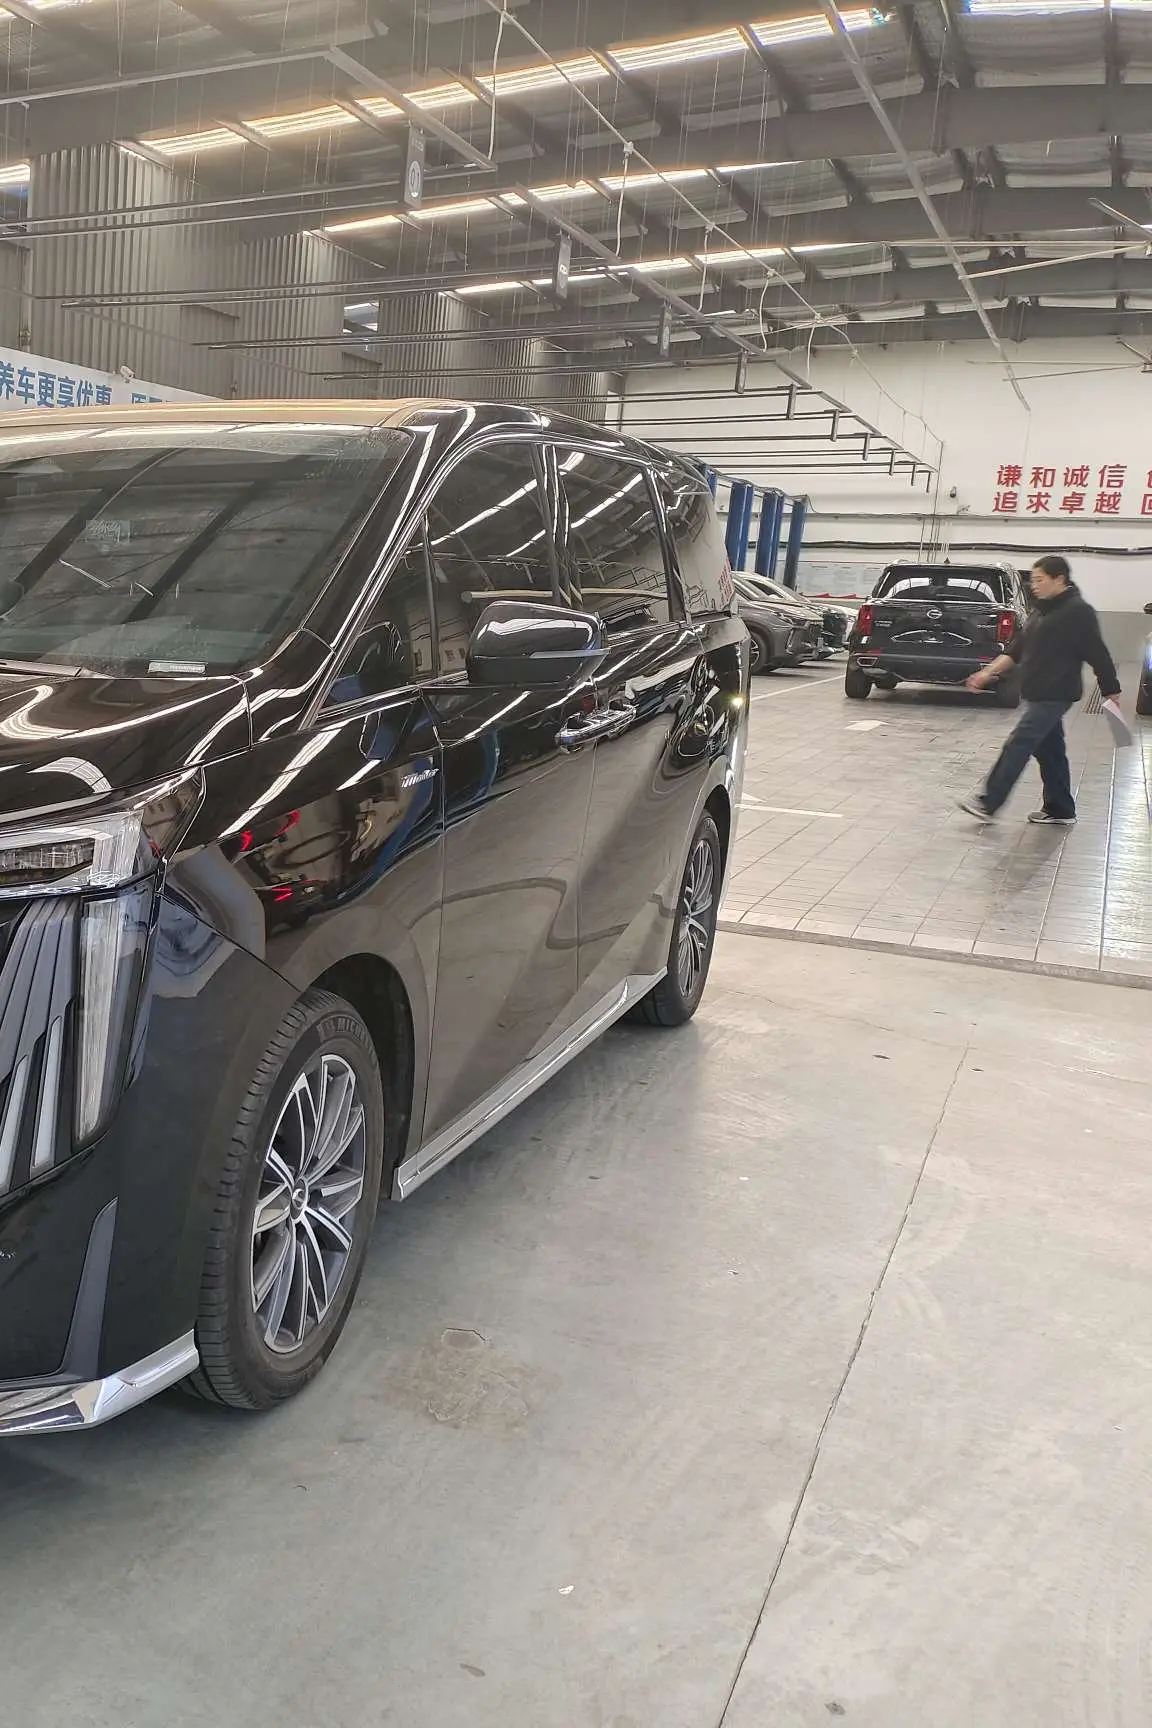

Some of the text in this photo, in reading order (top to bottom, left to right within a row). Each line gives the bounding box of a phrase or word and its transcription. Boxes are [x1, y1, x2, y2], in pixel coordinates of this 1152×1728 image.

[997, 464, 1127, 488] 谦和诚信
[992, 491, 1122, 515] 追求卓越
